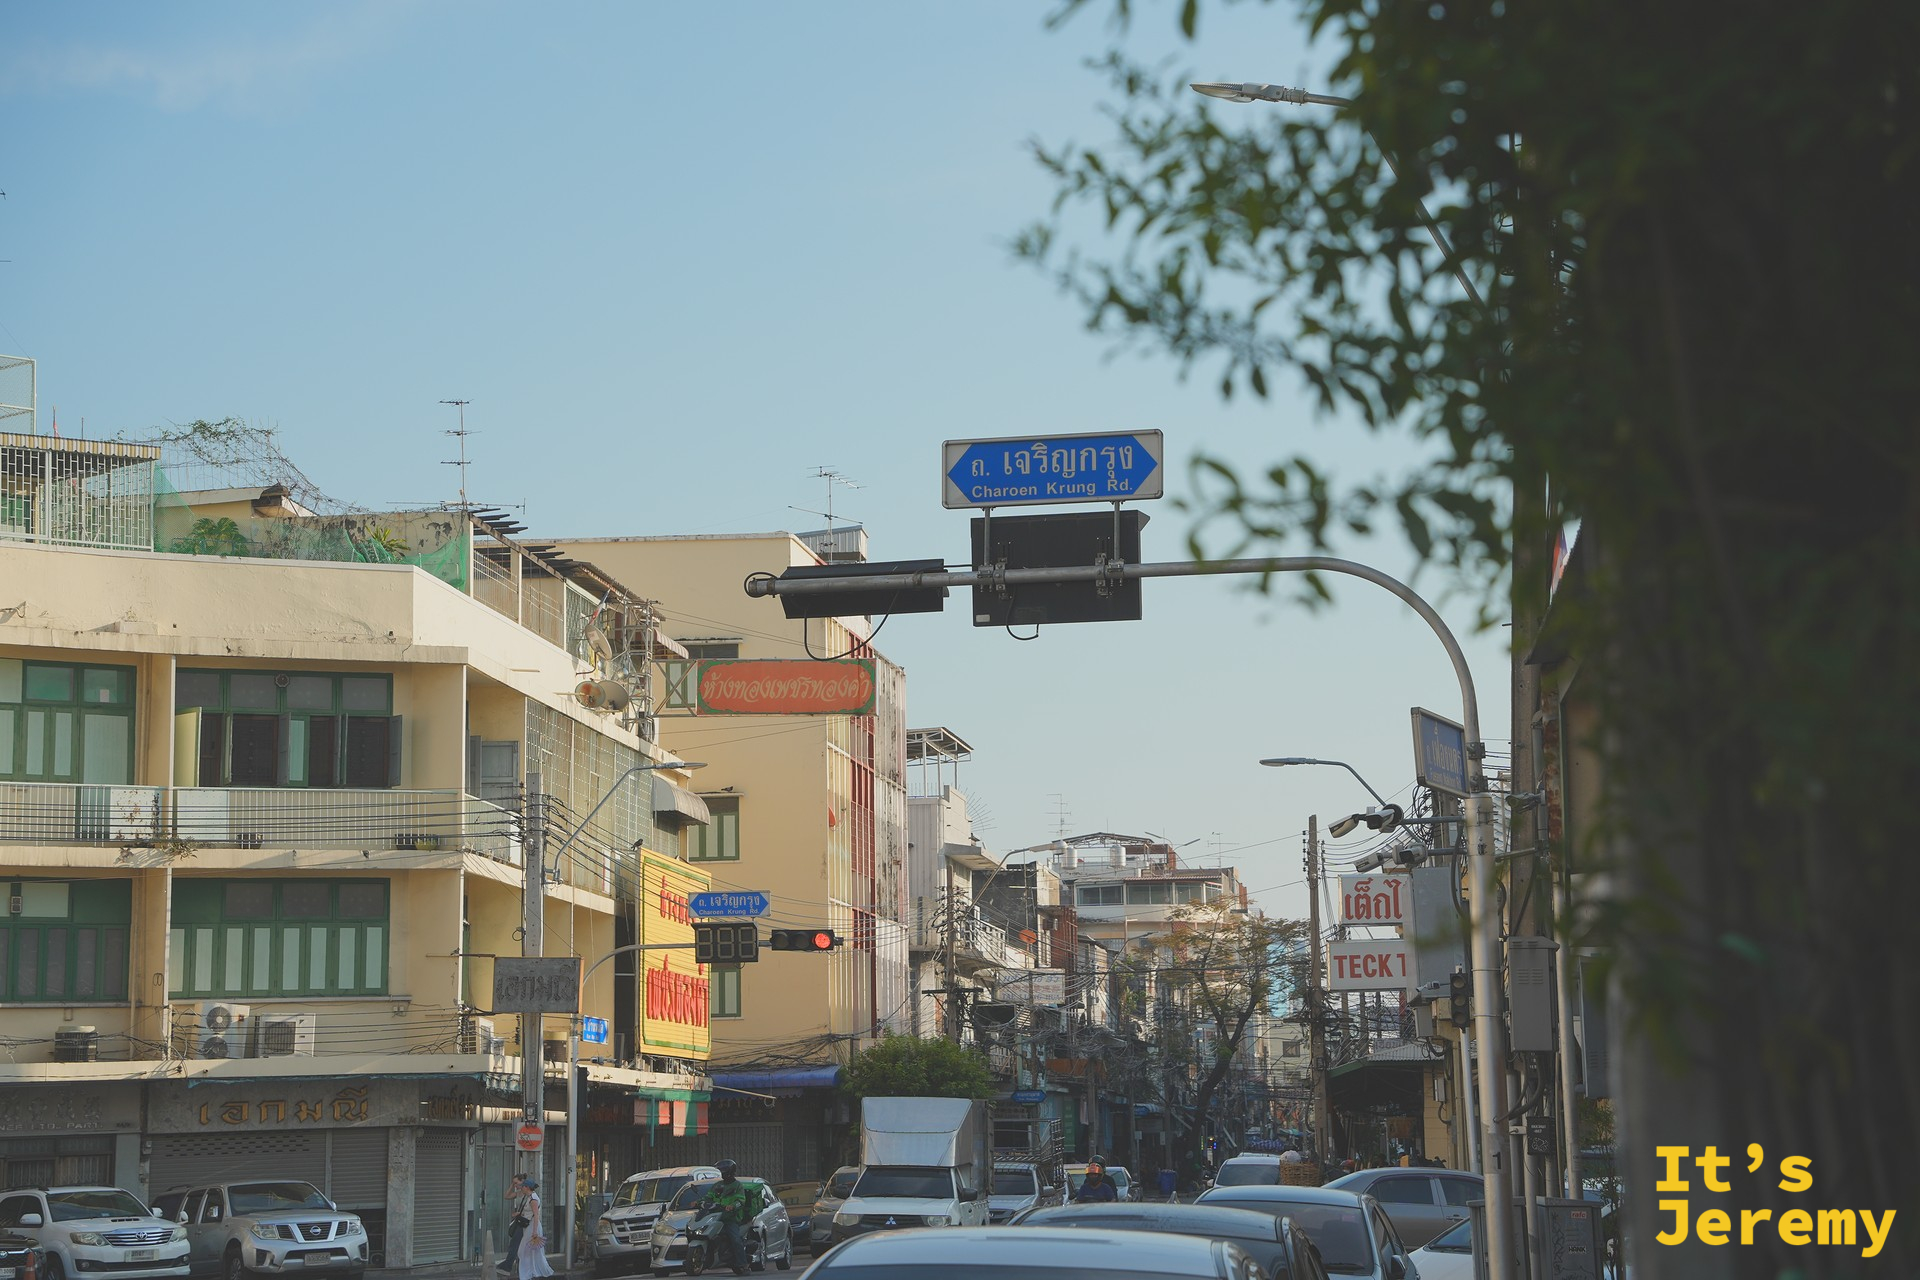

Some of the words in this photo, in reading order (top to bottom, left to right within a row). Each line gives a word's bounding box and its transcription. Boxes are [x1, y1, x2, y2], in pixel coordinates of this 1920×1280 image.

[971, 458, 990, 477] ถ.
[1003, 442, 1133, 479] เจริญกรุง
[972, 484, 1038, 499] Charoen
[1046, 481, 1097, 496] Krung
[1107, 479, 1133, 492] Rd.
[710, 894, 760, 909] เจริญกรุง
[1333, 953, 1393, 979] TECK
[199, 1086, 370, 1126] เอกมณี
[1492, 1151, 1502, 1170] 1
